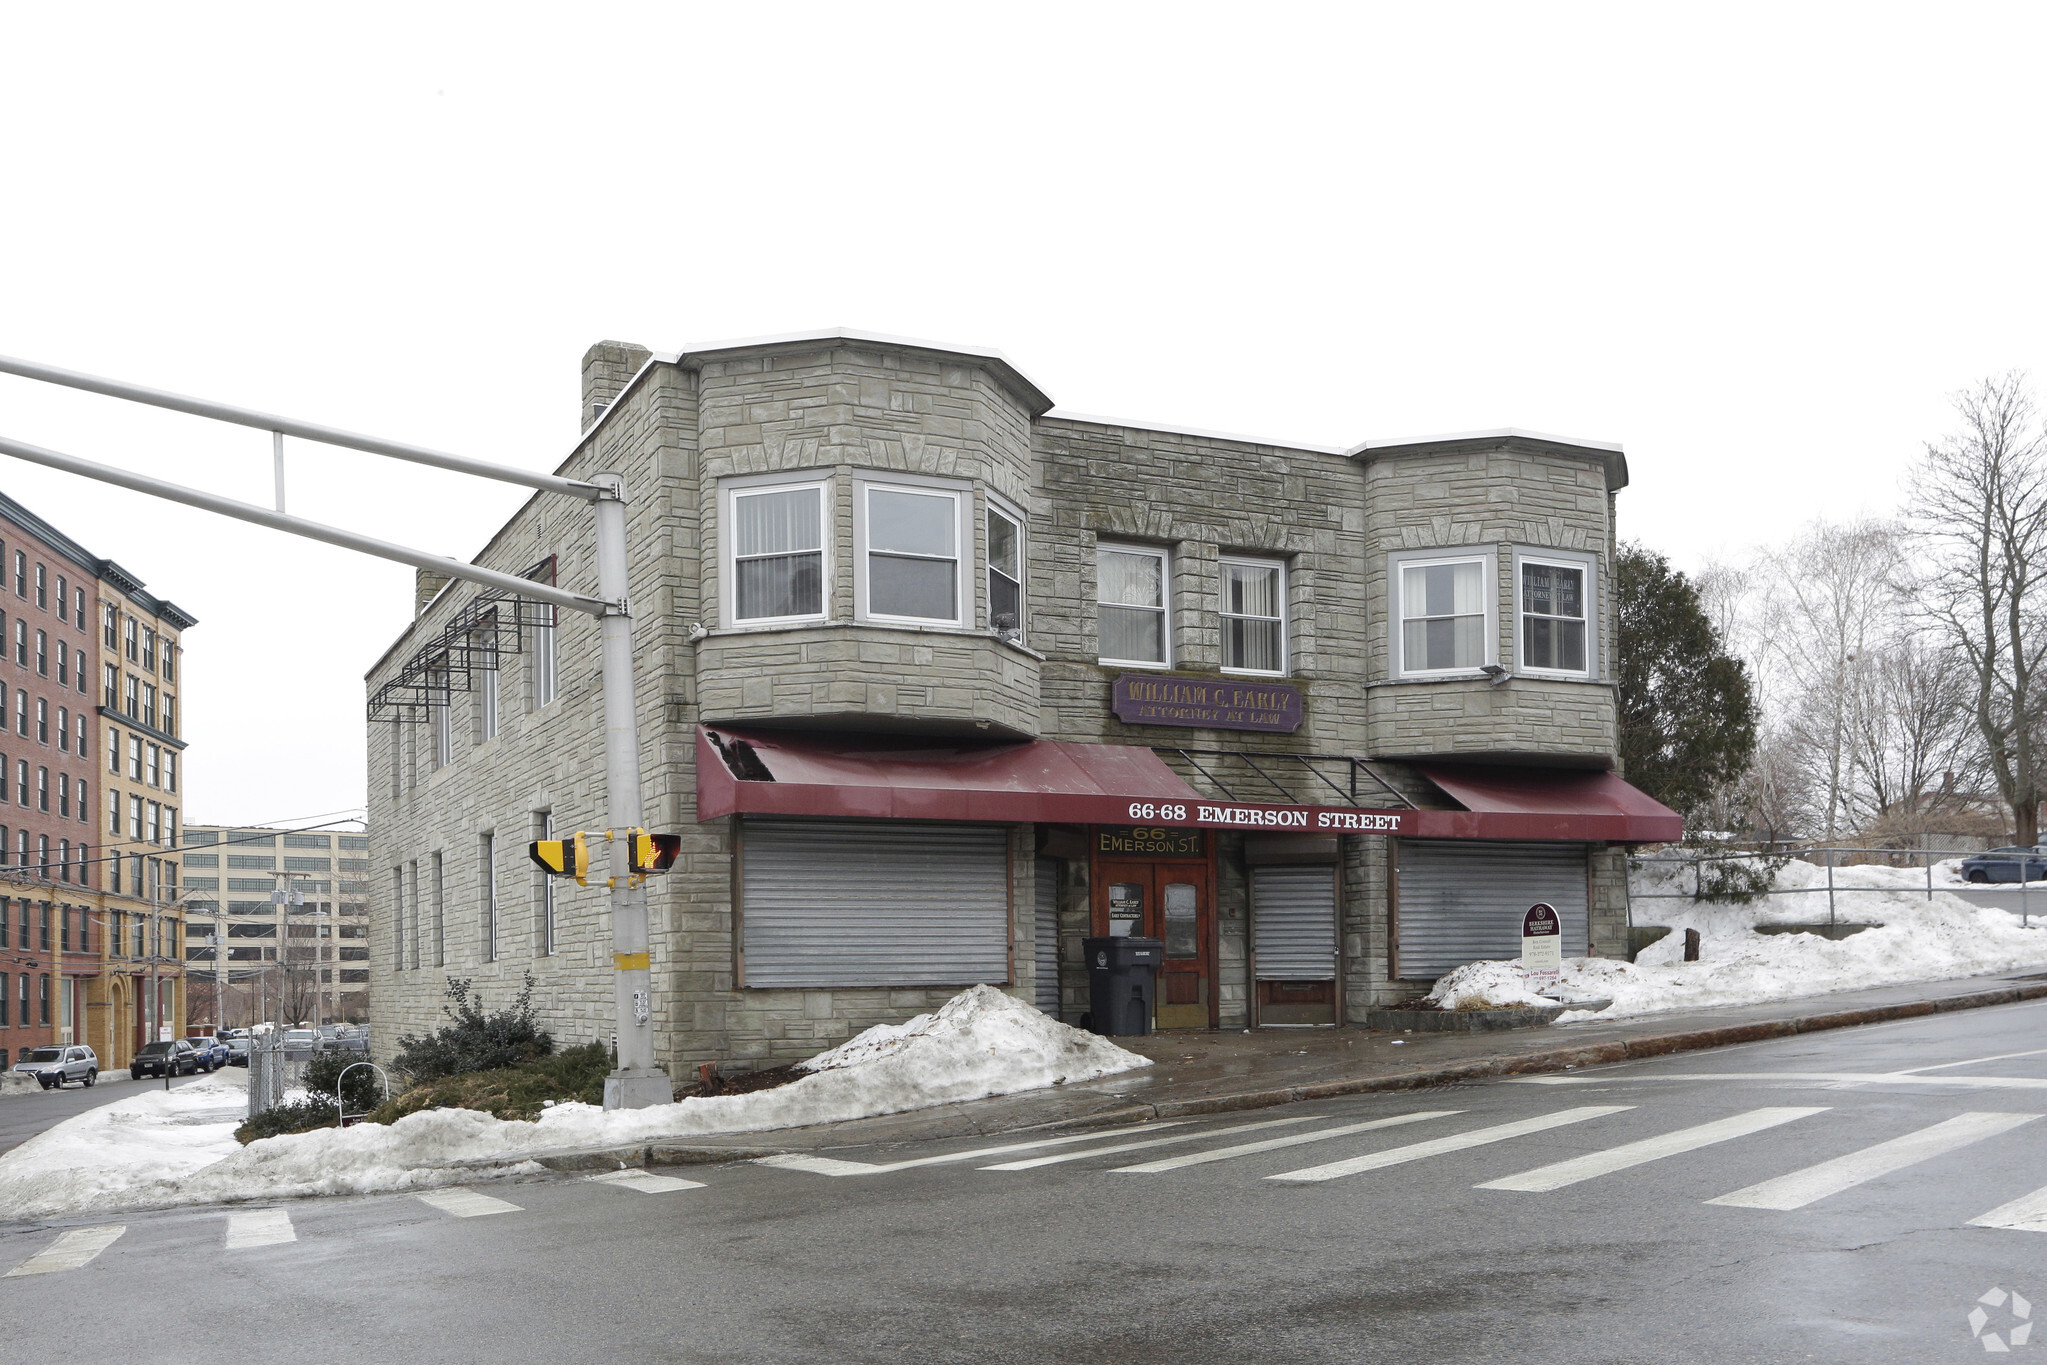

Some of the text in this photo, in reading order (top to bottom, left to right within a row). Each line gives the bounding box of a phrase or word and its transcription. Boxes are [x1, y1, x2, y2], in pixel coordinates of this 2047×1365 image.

[1128, 681, 1290, 711] WILLIAM C. EARLY
[1138, 705, 1281, 724] ATTORNEY AT LAW
[1128, 803, 1401, 831] 66-68 EMERSON STREET
[1100, 833, 1199, 853] EMERSON ST.
[1132, 827, 1167, 840] 66
